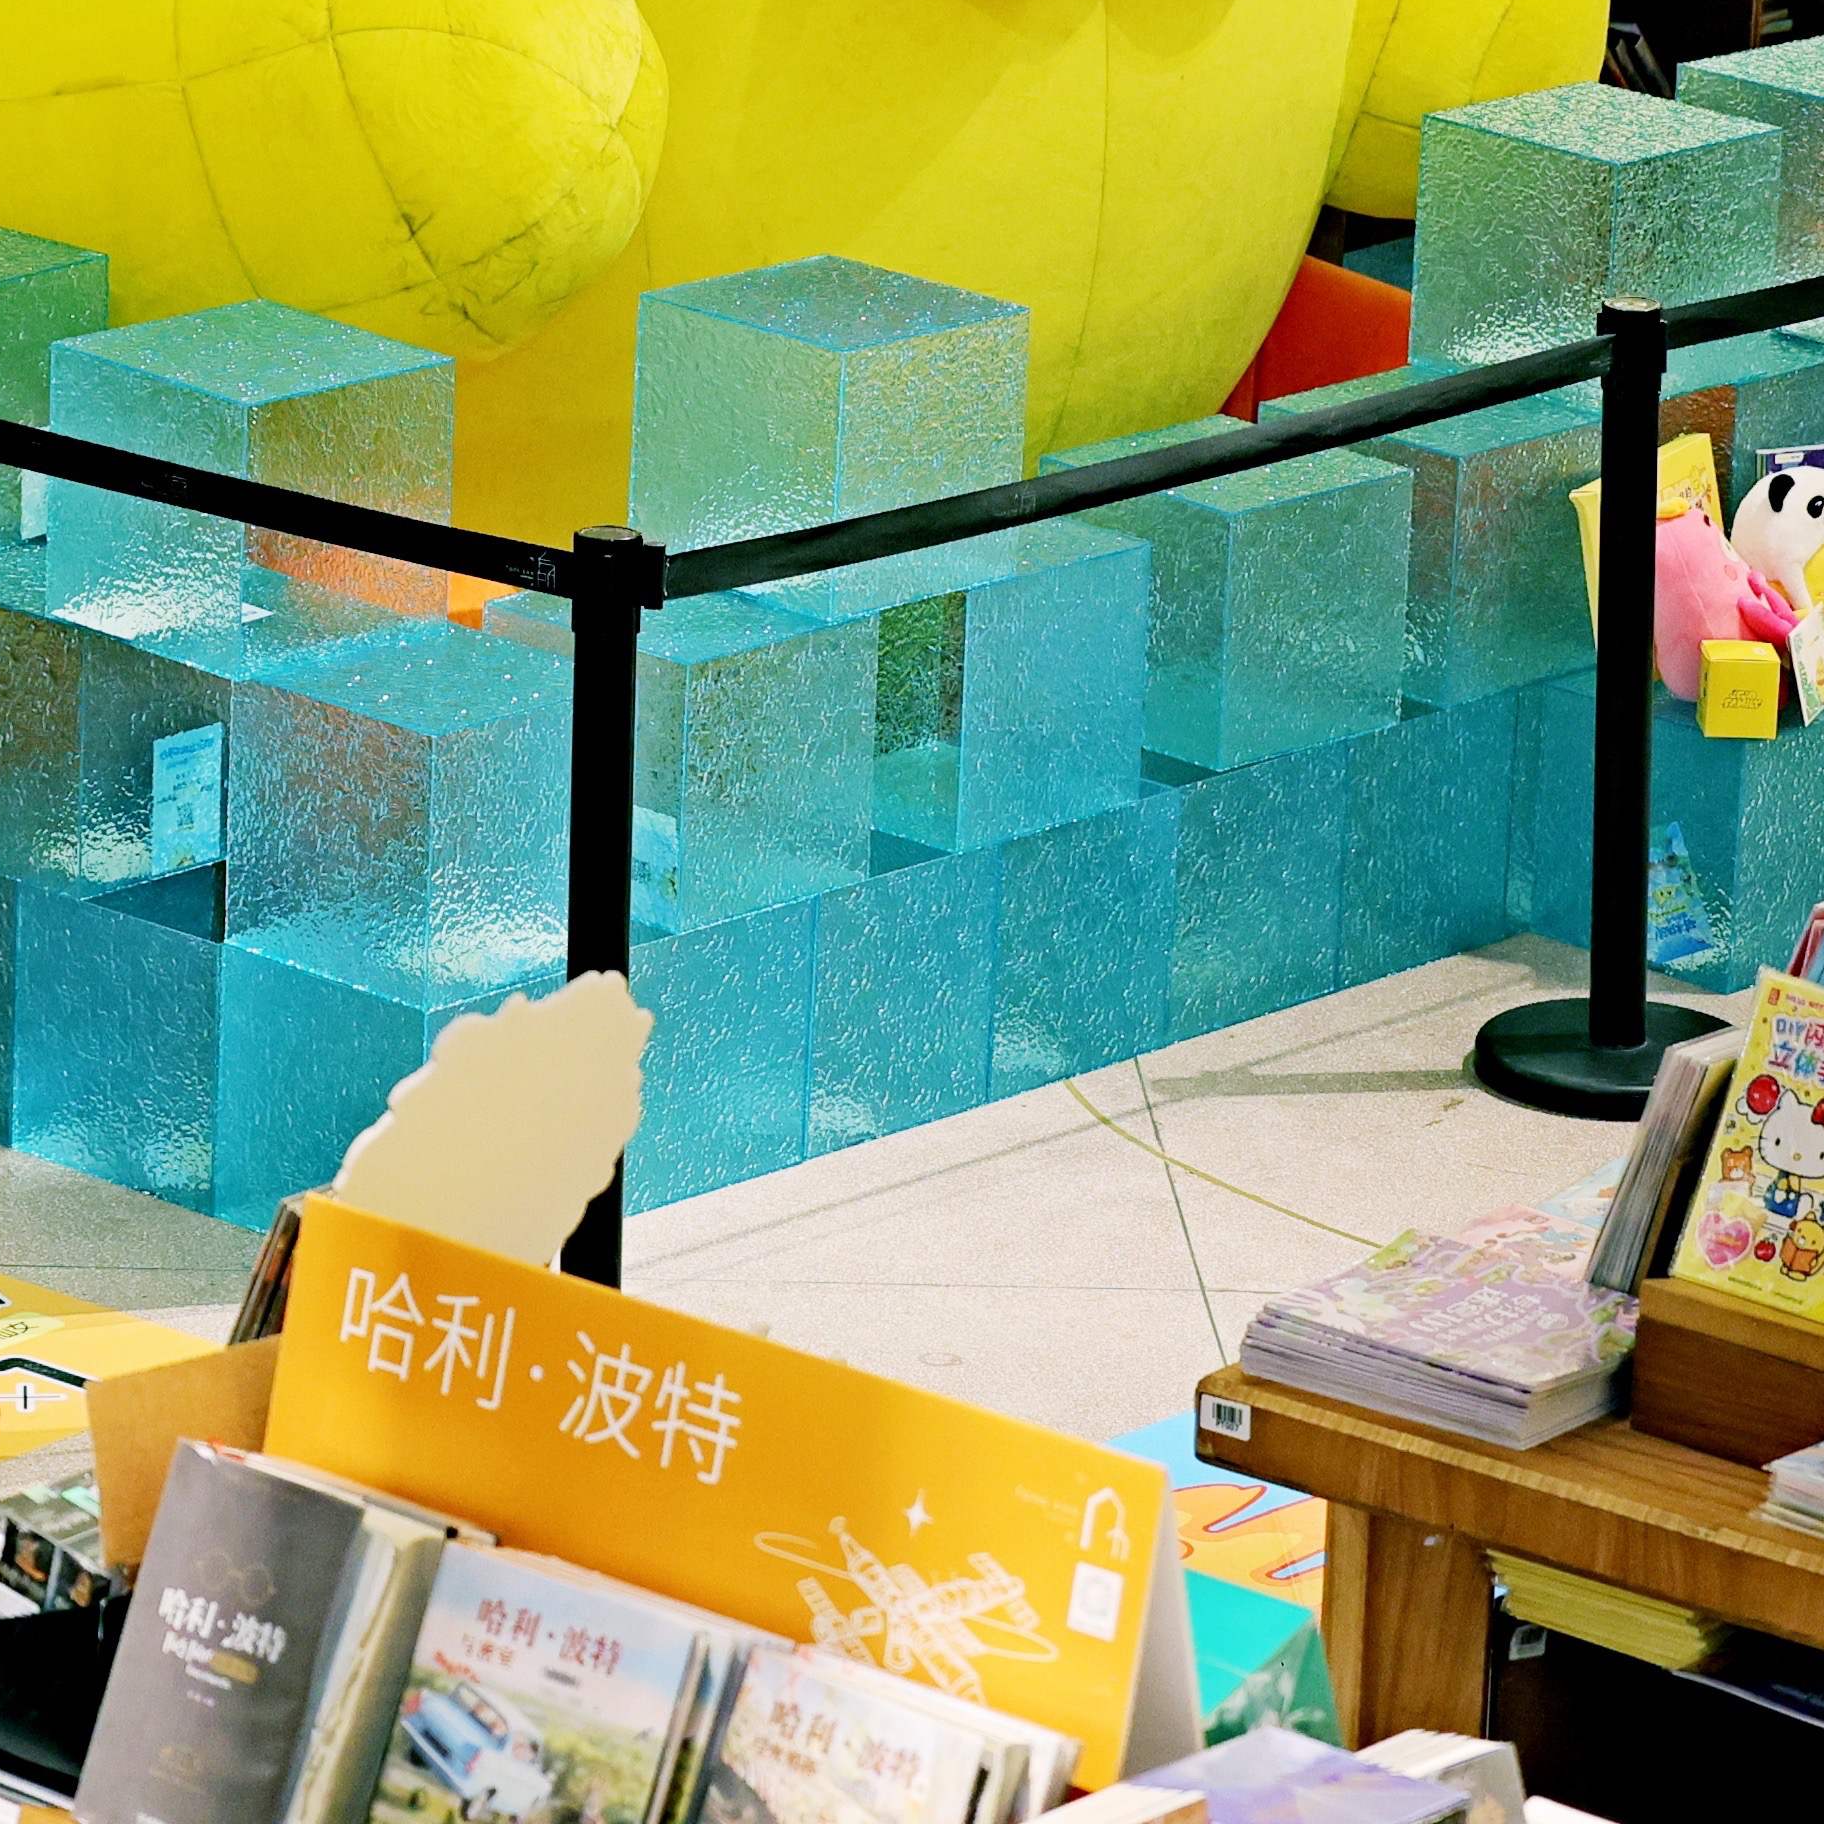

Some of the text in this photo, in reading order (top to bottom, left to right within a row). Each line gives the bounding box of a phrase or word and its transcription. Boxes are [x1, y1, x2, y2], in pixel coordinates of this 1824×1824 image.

[339, 1267, 743, 1486] 哈利·波特
[478, 1597, 625, 1676] 哈利·波特
